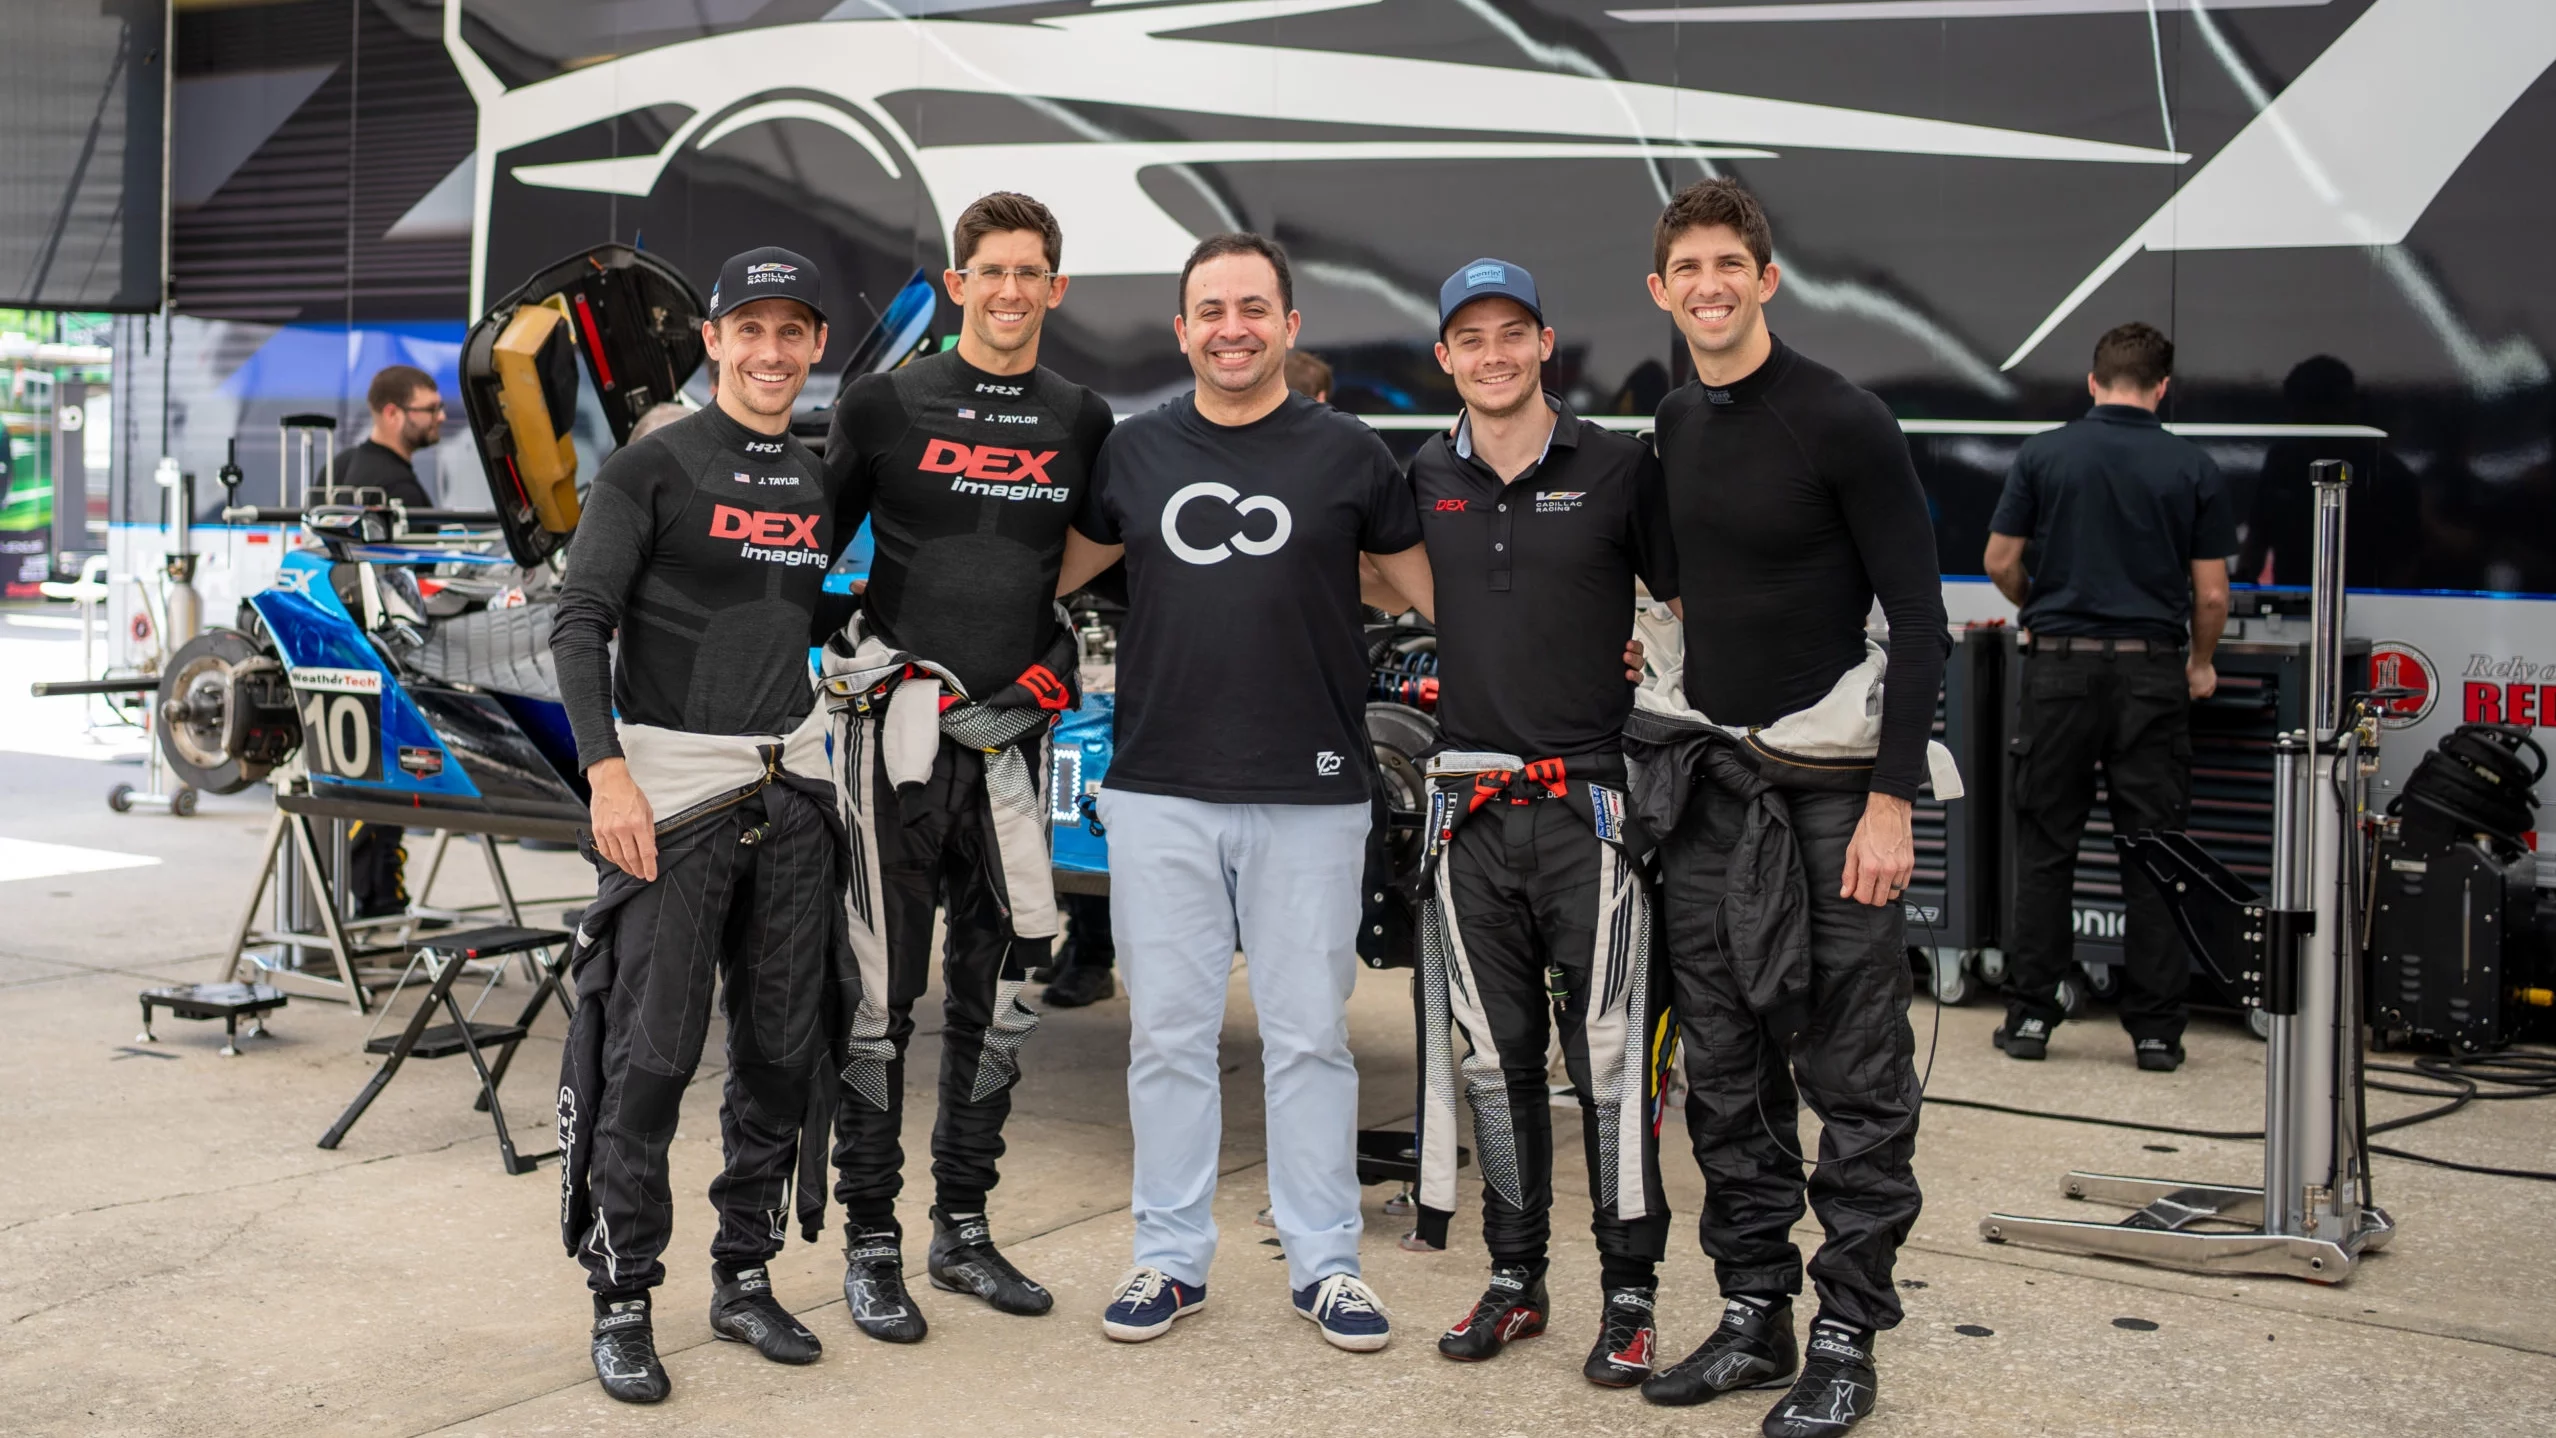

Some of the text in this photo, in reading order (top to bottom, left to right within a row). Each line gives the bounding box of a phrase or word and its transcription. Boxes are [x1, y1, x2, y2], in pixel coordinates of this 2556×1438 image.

[747, 272, 797, 281] CADILLAC
[747, 277, 785, 286] RACING
[975, 383, 1025, 396] HRX
[985, 414, 1038, 425] J. TAYLOR
[745, 441, 784, 453] HRX
[917, 438, 1060, 484] DEX
[758, 477, 800, 486] J. TAYLOR
[951, 475, 1070, 503] imaging
[1434, 499, 1469, 512] DEX
[709, 503, 821, 549] DEX
[740, 542, 829, 569] imaging
[273, 567, 320, 593] EX
[2462, 654, 2556, 684] Rely o
[304, 694, 371, 778] 10
